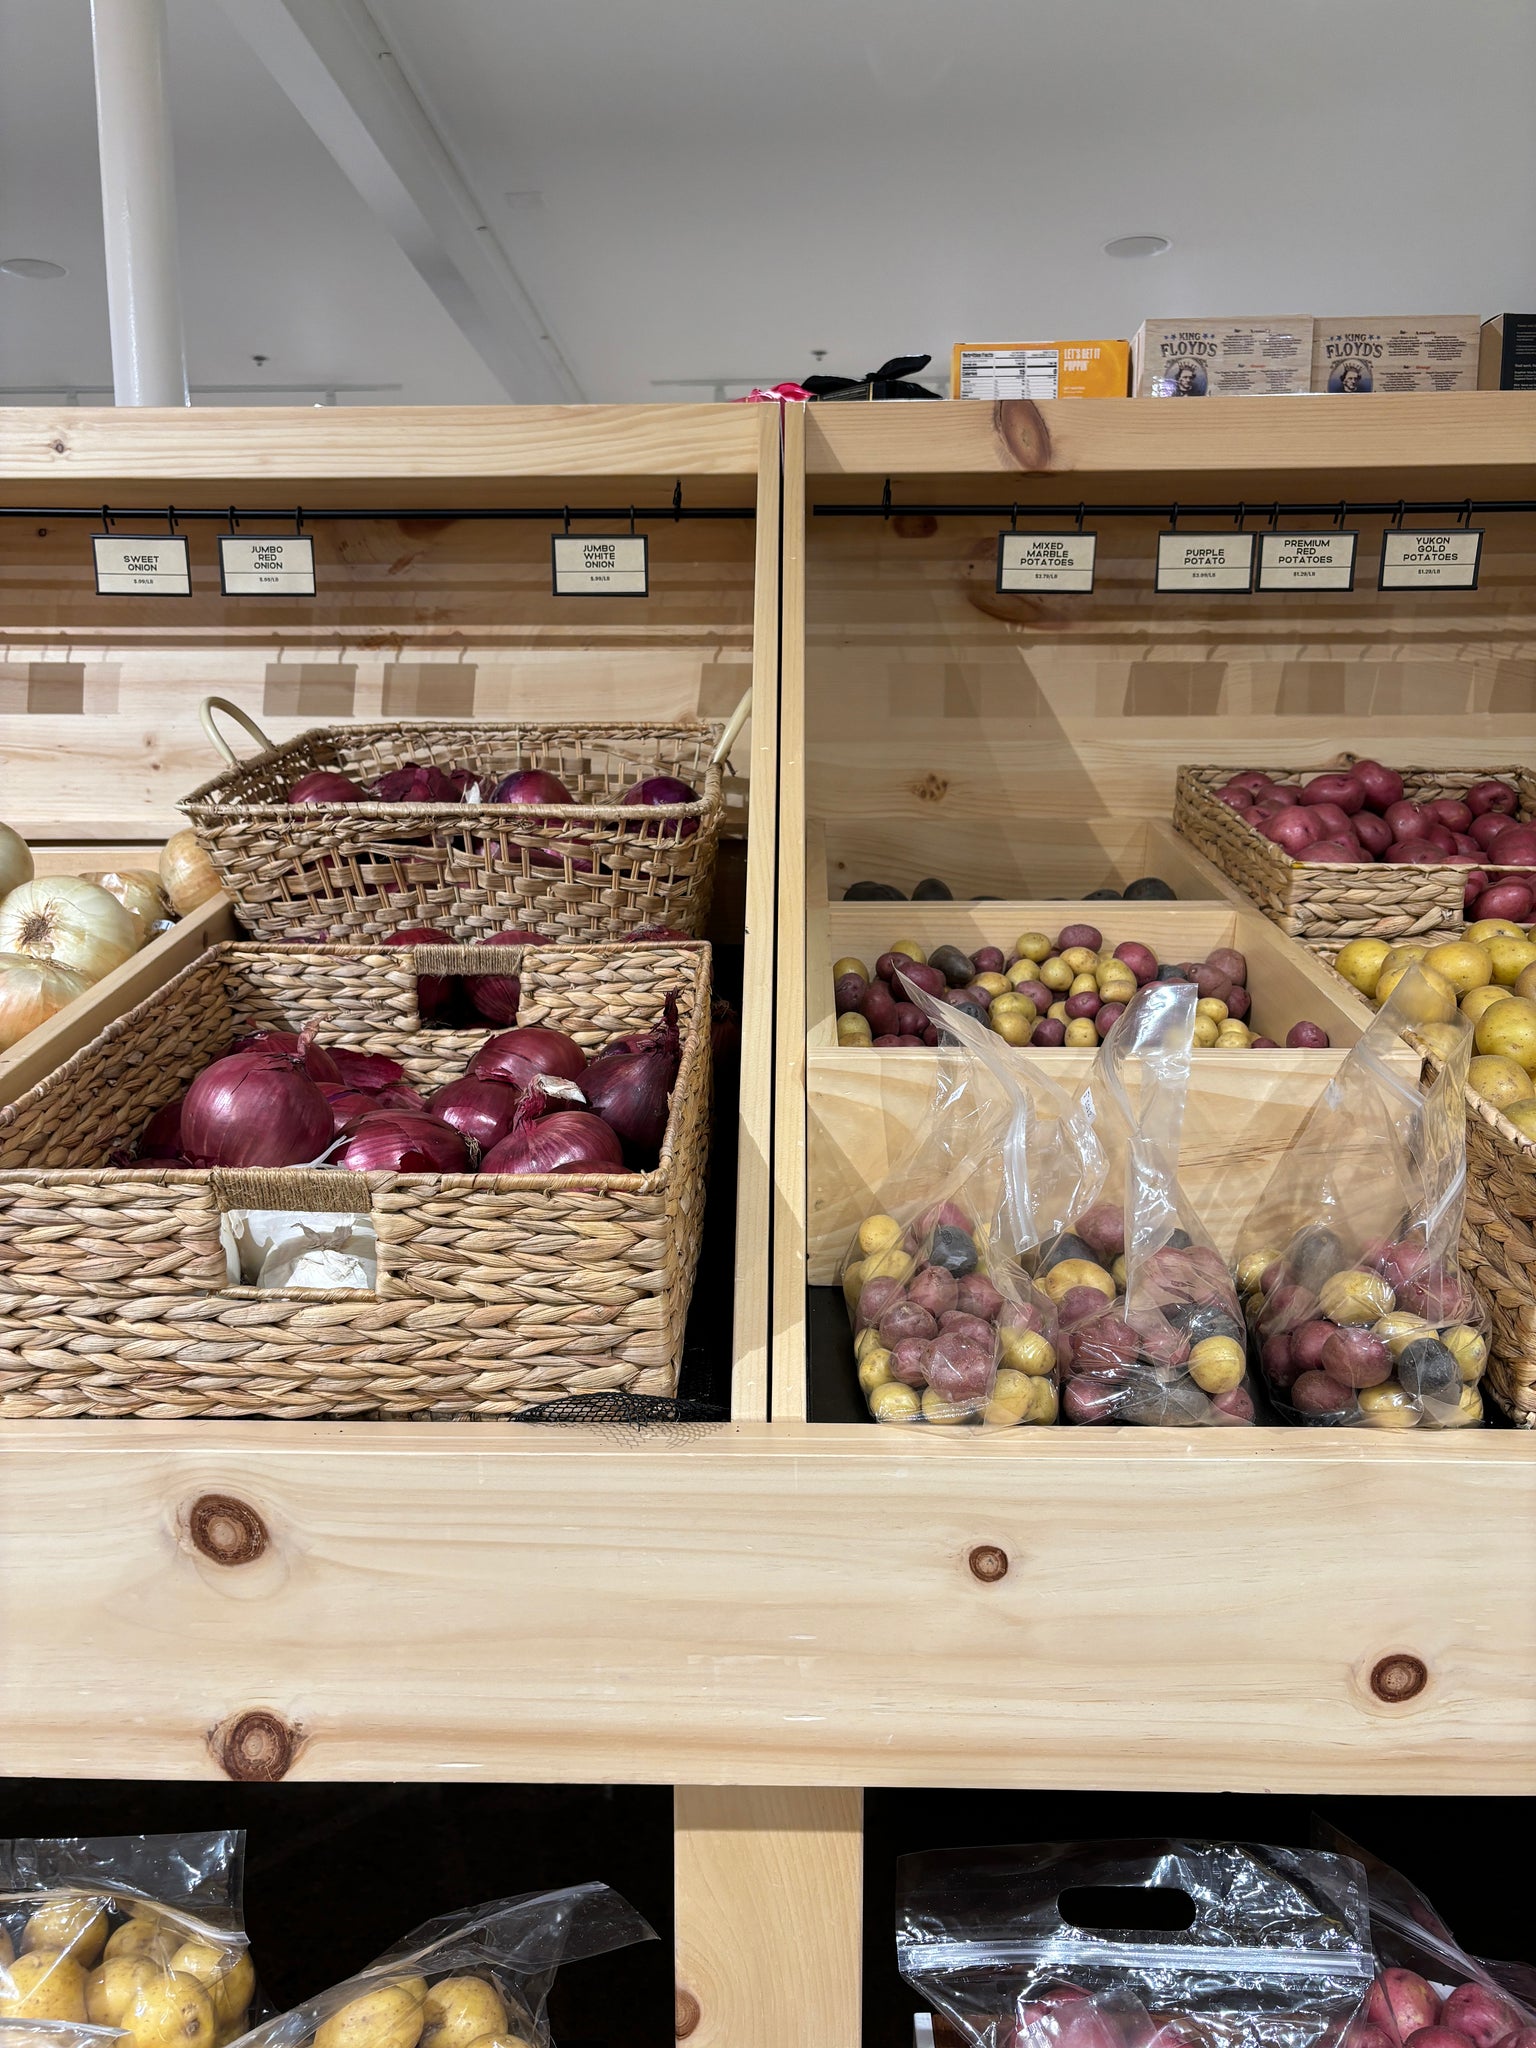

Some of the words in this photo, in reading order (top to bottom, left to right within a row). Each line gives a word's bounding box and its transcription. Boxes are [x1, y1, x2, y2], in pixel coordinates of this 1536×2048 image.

[1179, 333, 1200, 341] KING
[1345, 333, 1366, 341] KING
[1064, 348, 1080, 359] LET'S
[1160, 341, 1218, 358] FLOYD'S
[1326, 343, 1384, 358] FLOYD'S
[1033, 542, 1063, 550] MIXED
[1027, 550, 1069, 558] MARBLE
[1403, 553, 1458, 561] POTATOES
[123, 555, 159, 563] SWEET
[1020, 558, 1074, 566] POTATOES
[1278, 556, 1333, 564] POTATOES
